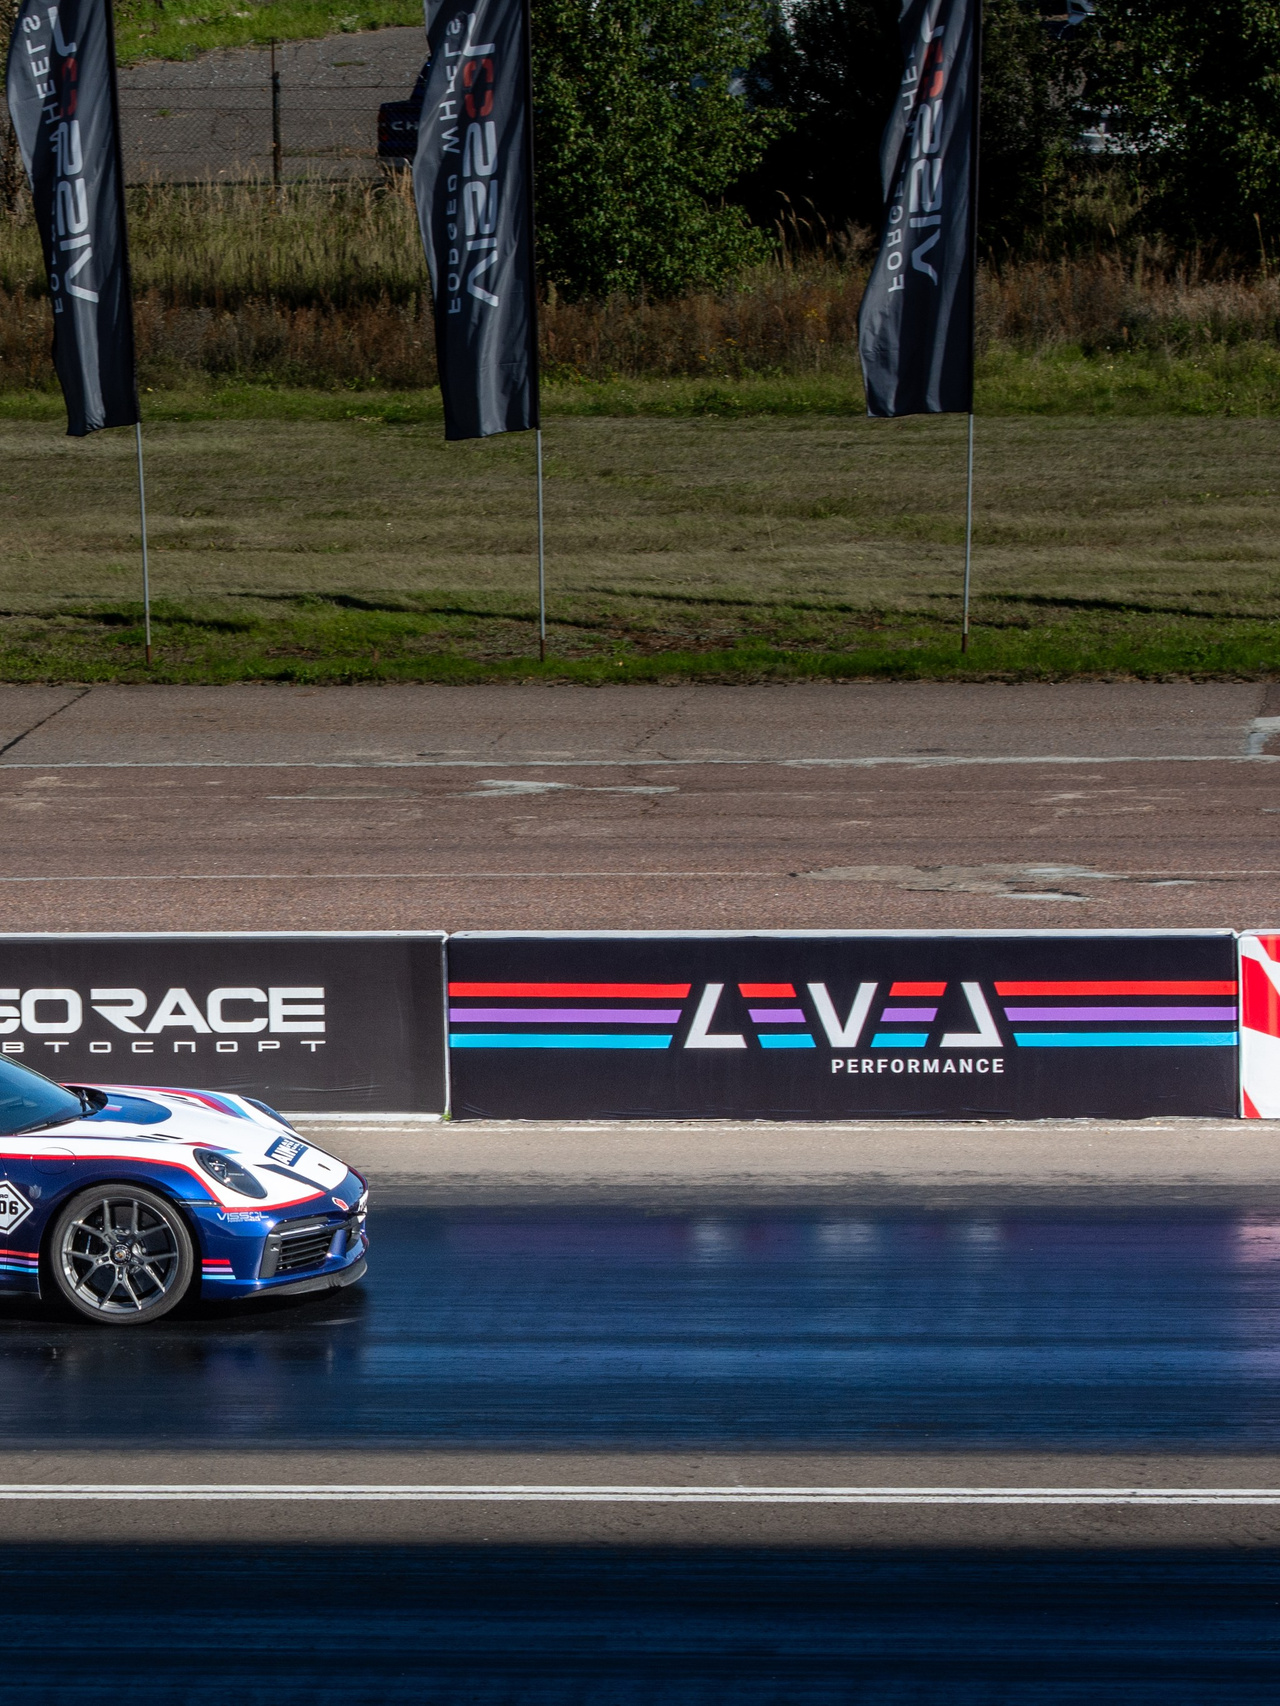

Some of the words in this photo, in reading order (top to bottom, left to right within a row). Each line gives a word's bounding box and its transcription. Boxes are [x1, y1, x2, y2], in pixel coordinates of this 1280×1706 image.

[2, 1040, 326, 1053] ВТОСПОРТ
[831, 1058, 1005, 1074] PERFORMANCE
[216, 1211, 270, 1221] VISSOL
